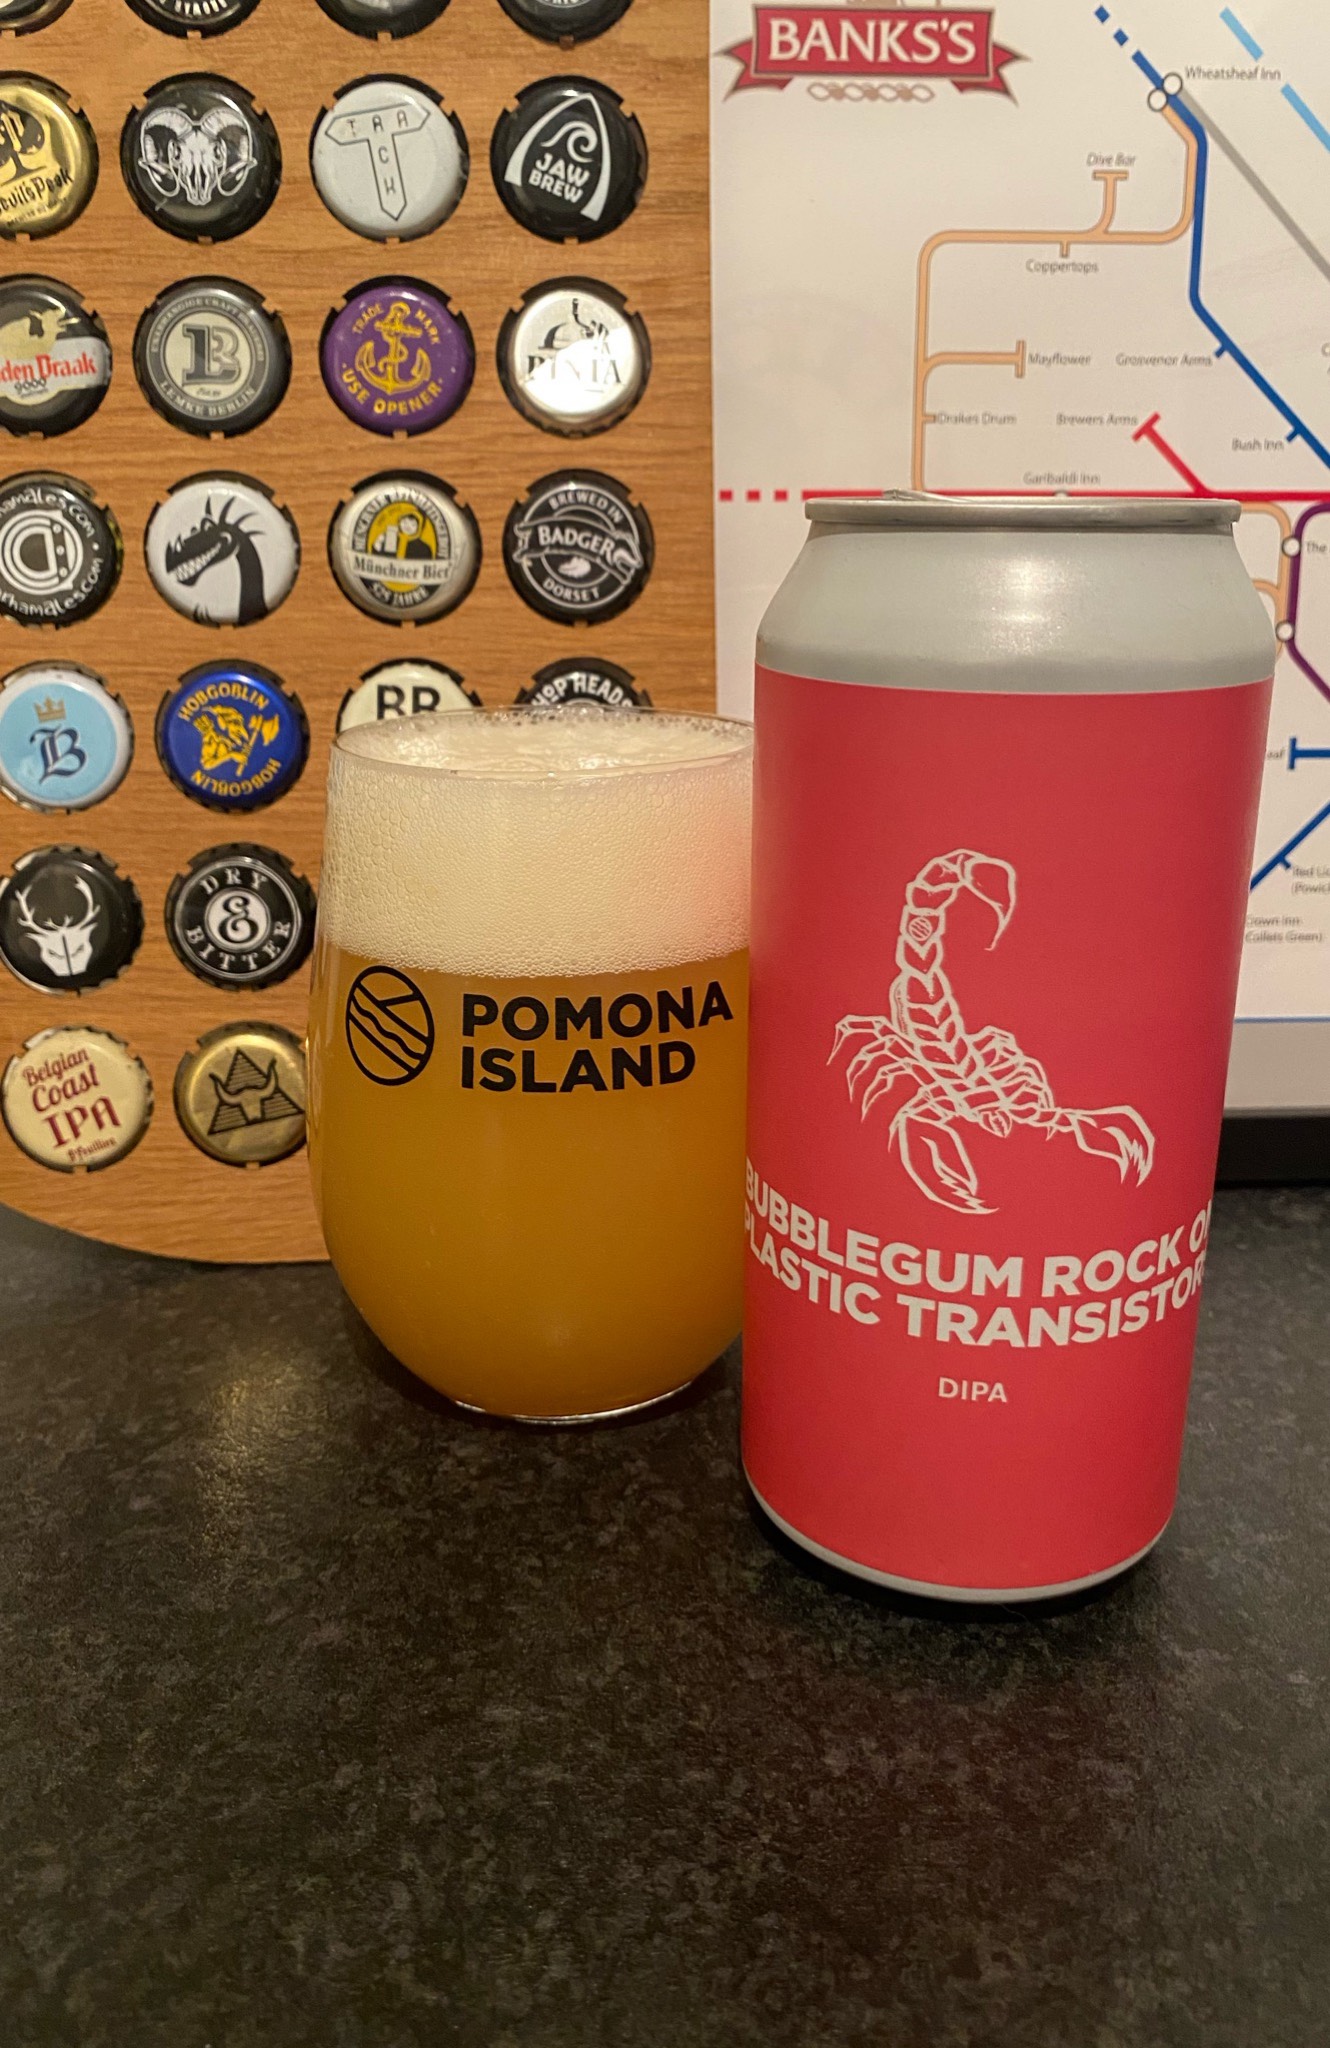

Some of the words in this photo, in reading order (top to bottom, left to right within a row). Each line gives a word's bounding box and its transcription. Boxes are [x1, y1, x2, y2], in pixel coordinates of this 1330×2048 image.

[768, 18, 976, 65] BANKS'S
[1185, 66, 1258, 81] Wheatsheaf
[1260, 68, 1281, 81] Inn
[528, 172, 583, 203] BREW
[535, 152, 590, 187] JAW
[0, 180, 36, 214] evil's
[1026, 259, 1099, 275] Coppertops
[352, 303, 384, 334] TRADE
[415, 308, 440, 345] MARK
[35, 352, 97, 380] Draak
[1028, 353, 1091, 366] Mayflower
[1116, 353, 1177, 366] Grosvenor
[1180, 354, 1213, 366] Arms
[342, 369, 370, 404] USE
[373, 381, 443, 416] OPENER
[981, 413, 1017, 425] Drum
[1056, 413, 1104, 425] Brewers
[1106, 414, 1138, 426] Arms
[1232, 438, 1262, 451] Bush
[1264, 438, 1284, 451] Inn
[548, 490, 609, 510] BREWED
[607, 505, 624, 523] IN
[537, 525, 616, 565] BADGER
[542, 577, 599, 602] DORSET
[178, 682, 270, 721] HOBGOBLIN
[191, 757, 282, 797] HOBGOBLIN
[200, 868, 269, 894] DRY
[220, 896, 259, 943] &
[187, 920, 291, 971] BITTER
[462, 980, 733, 1041] POMONA
[22, 1048, 90, 1086] Belgian
[461, 1041, 696, 1093] ISLAND
[32, 1063, 99, 1113] Coast
[44, 1095, 121, 1148] IPA
[745, 1156, 1023, 1298] BUBBLEGUM
[1041, 1224, 1184, 1298] ROCK
[744, 1199, 881, 1326] PLASTIC
[937, 1376, 1008, 1403] DIPA
